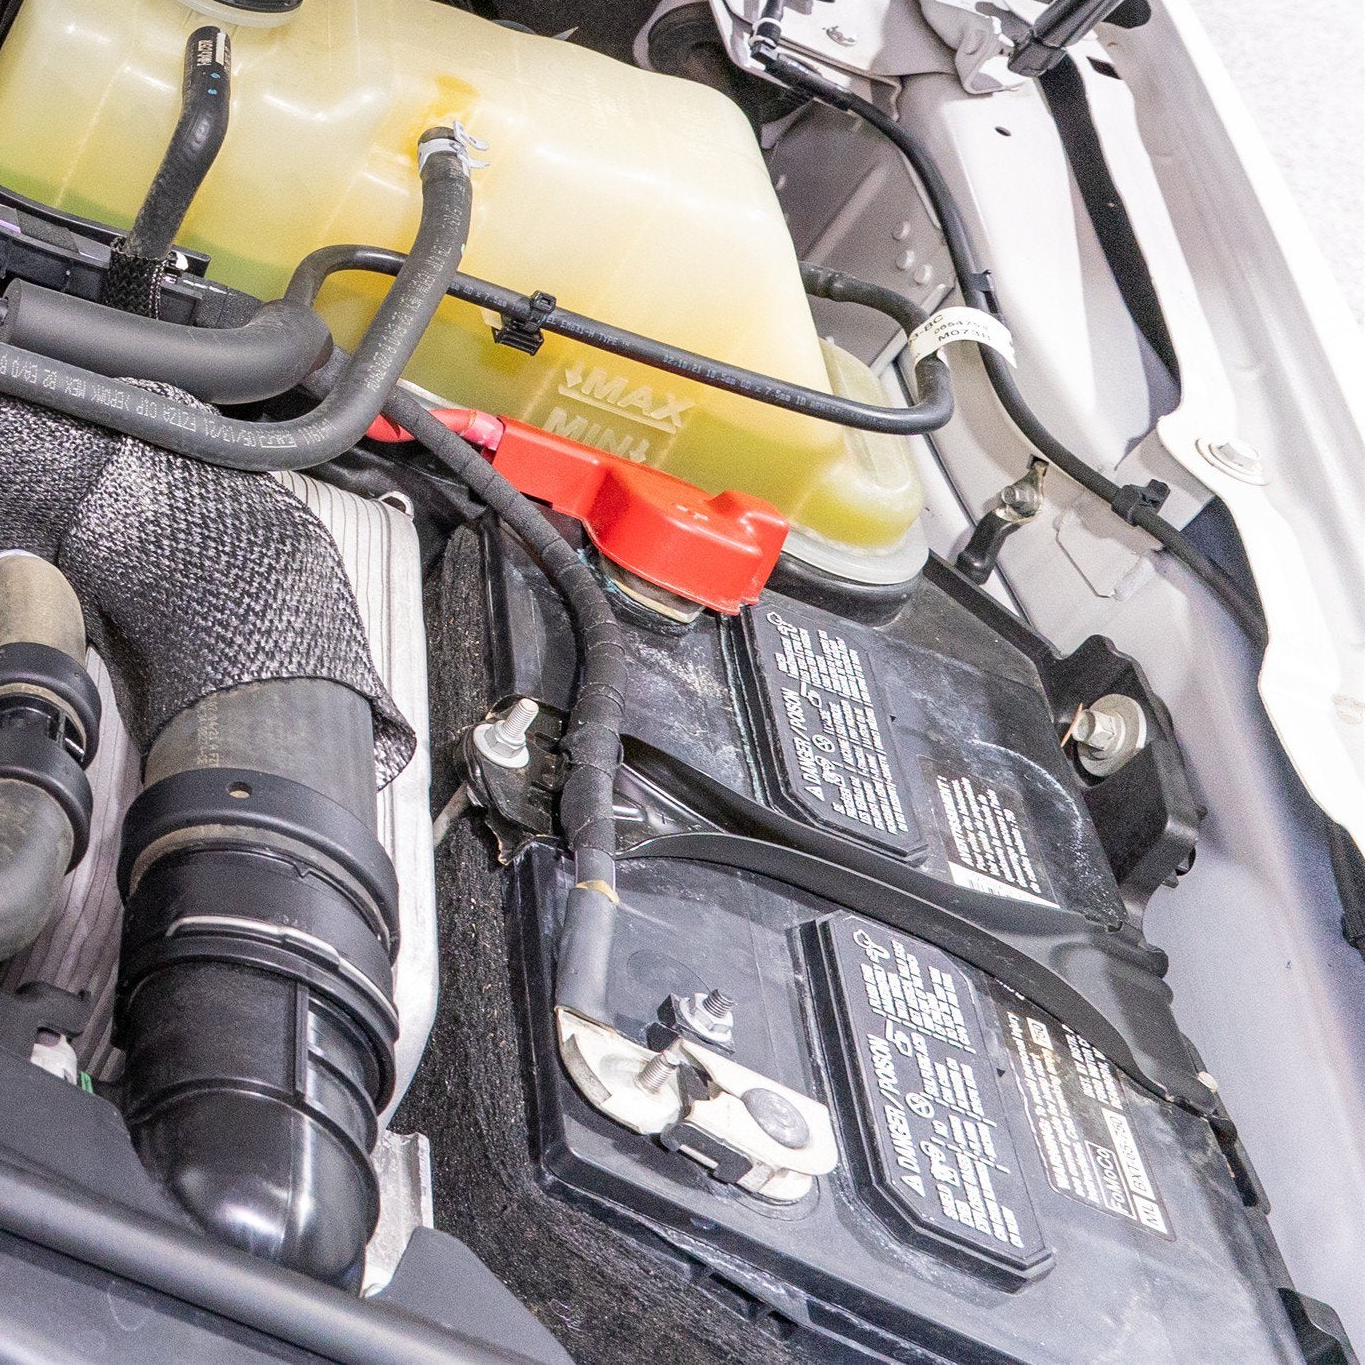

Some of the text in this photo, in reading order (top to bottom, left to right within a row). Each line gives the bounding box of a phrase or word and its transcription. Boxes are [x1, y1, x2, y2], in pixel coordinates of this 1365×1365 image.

[581, 368, 695, 428] MAX
[543, 406, 633, 455] MIN
[781, 687, 806, 727] POISON
[792, 737, 820, 783] DANGER
[867, 1034, 900, 1094] POISON
[882, 1105, 921, 1172] DANGER
[1093, 1148, 1128, 1212] FoMoCo
